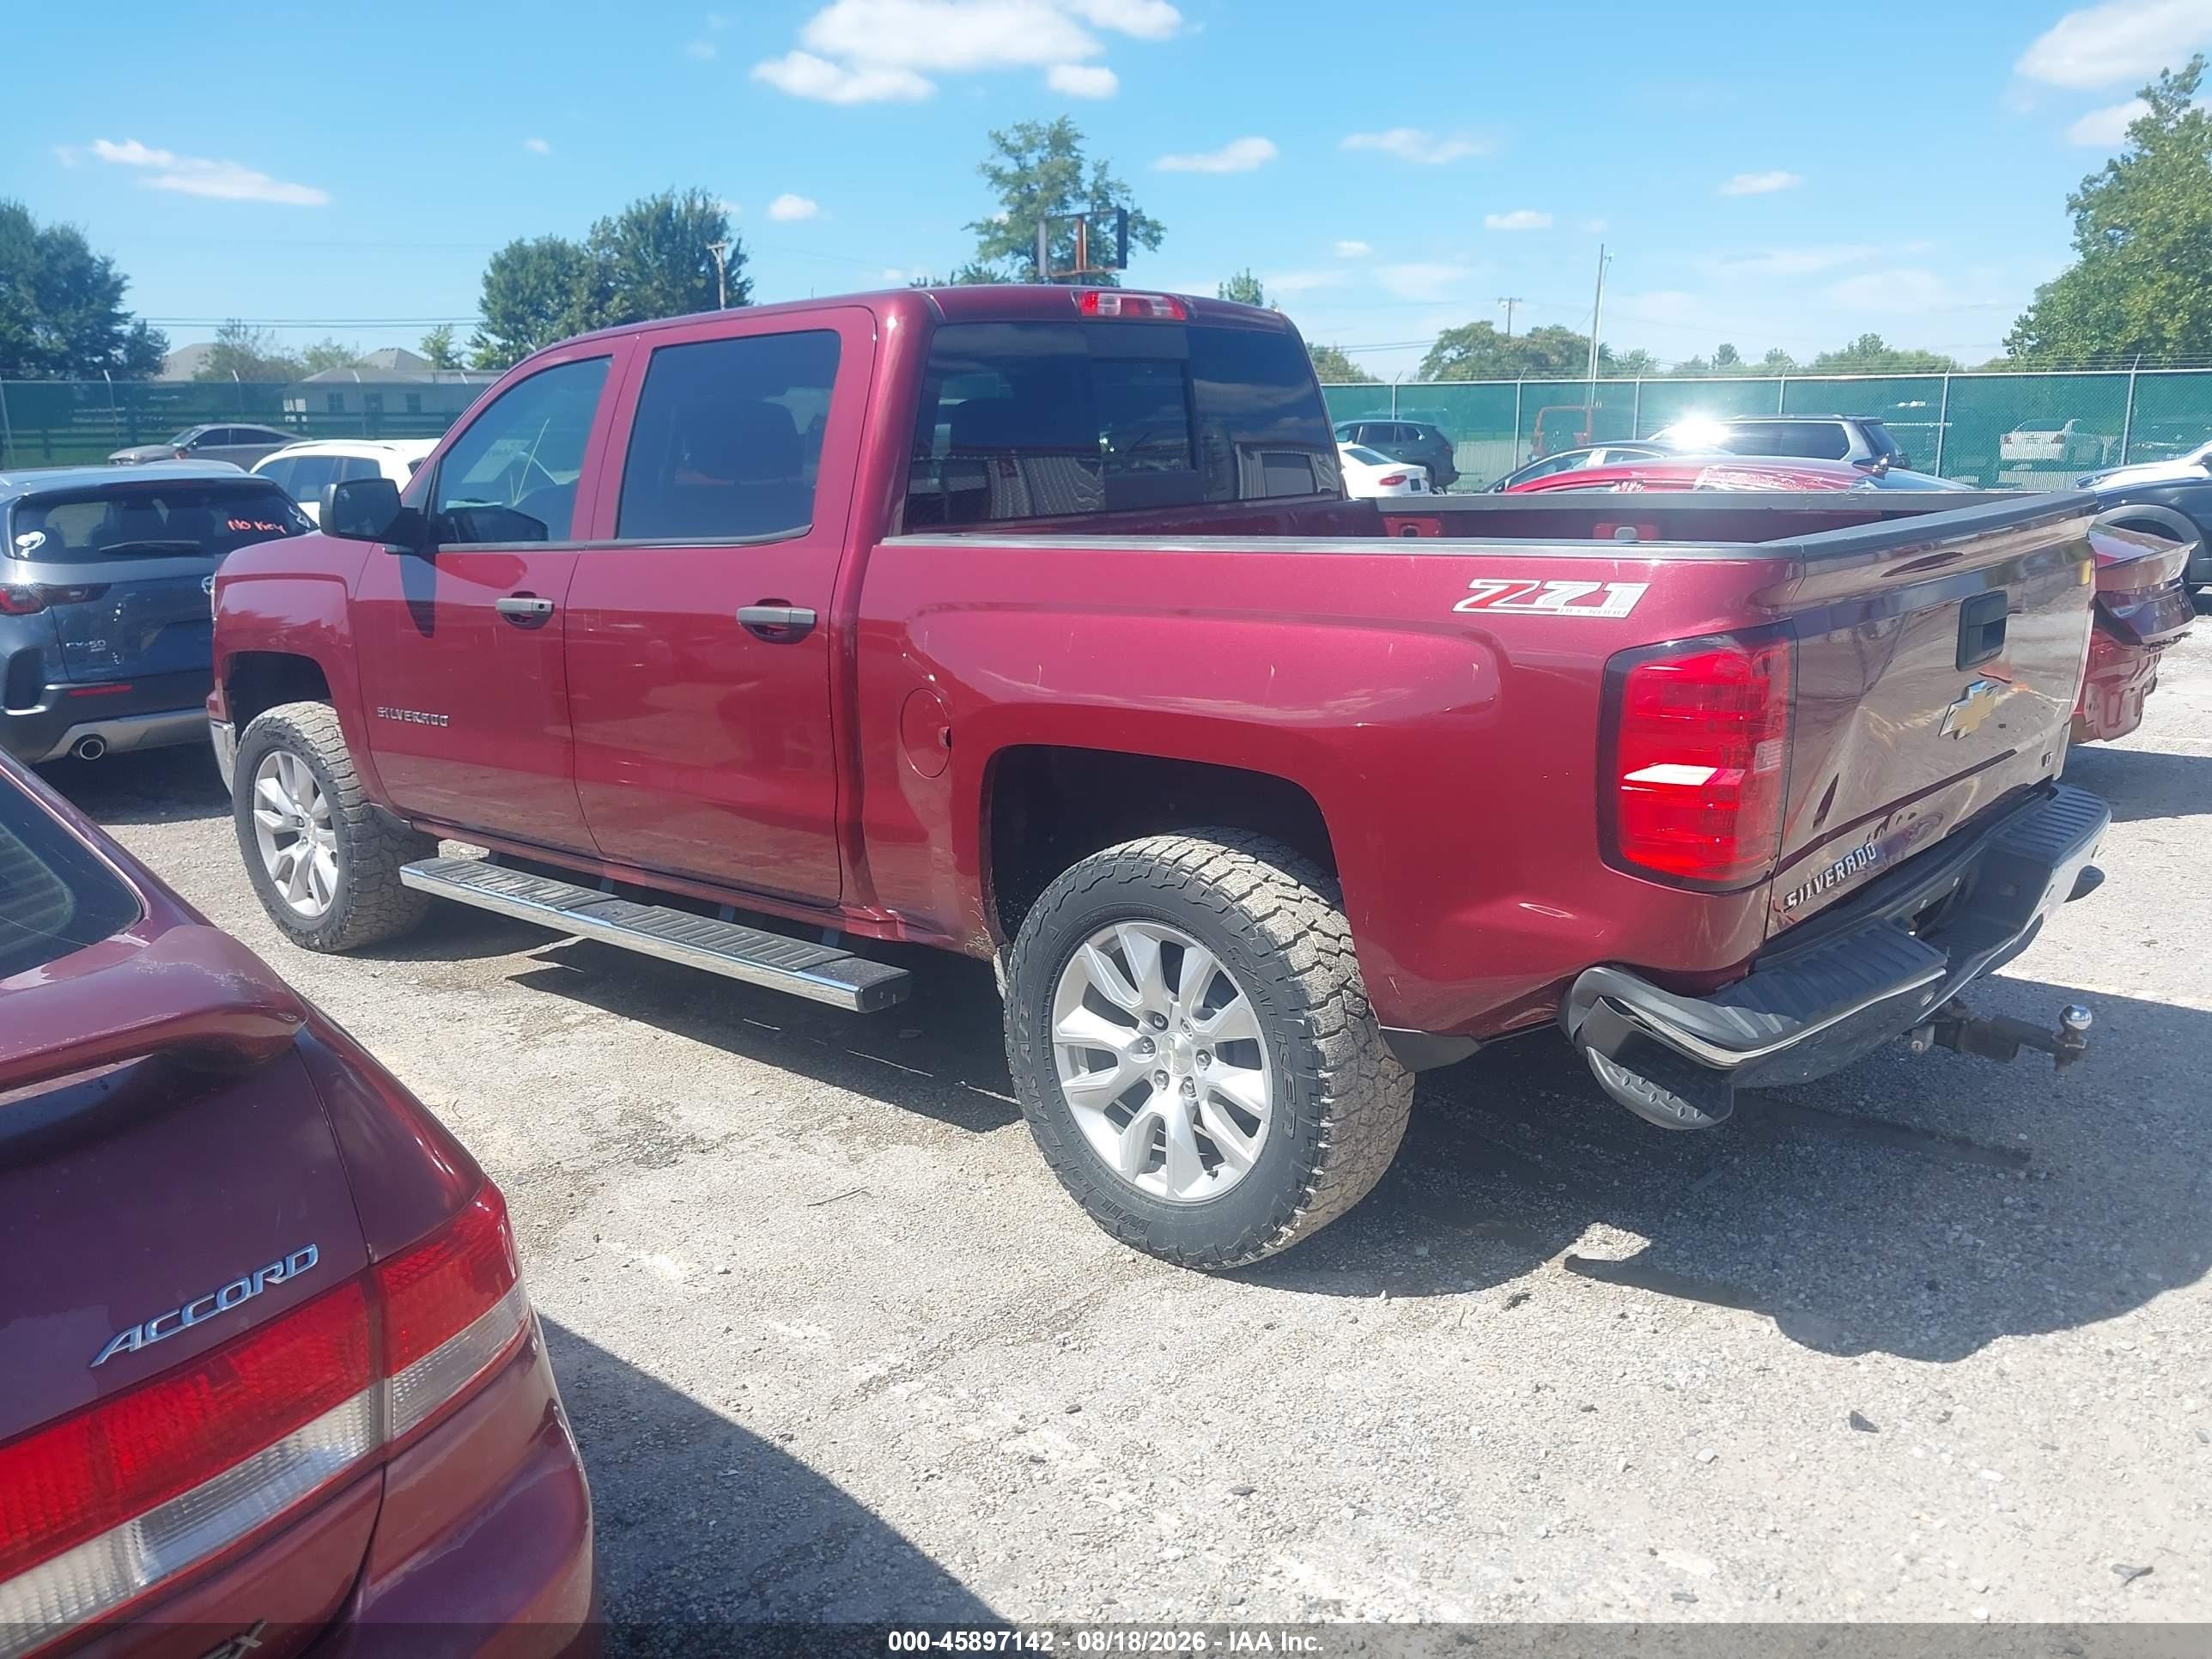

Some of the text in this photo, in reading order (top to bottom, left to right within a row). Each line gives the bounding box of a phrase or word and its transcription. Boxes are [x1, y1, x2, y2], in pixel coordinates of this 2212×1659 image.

[1452, 578, 1651, 618] Z71
[377, 706, 449, 728] SILVERADO
[1785, 841, 1877, 908] SILVERADO
[88, 1243, 318, 1368] ACCORD
